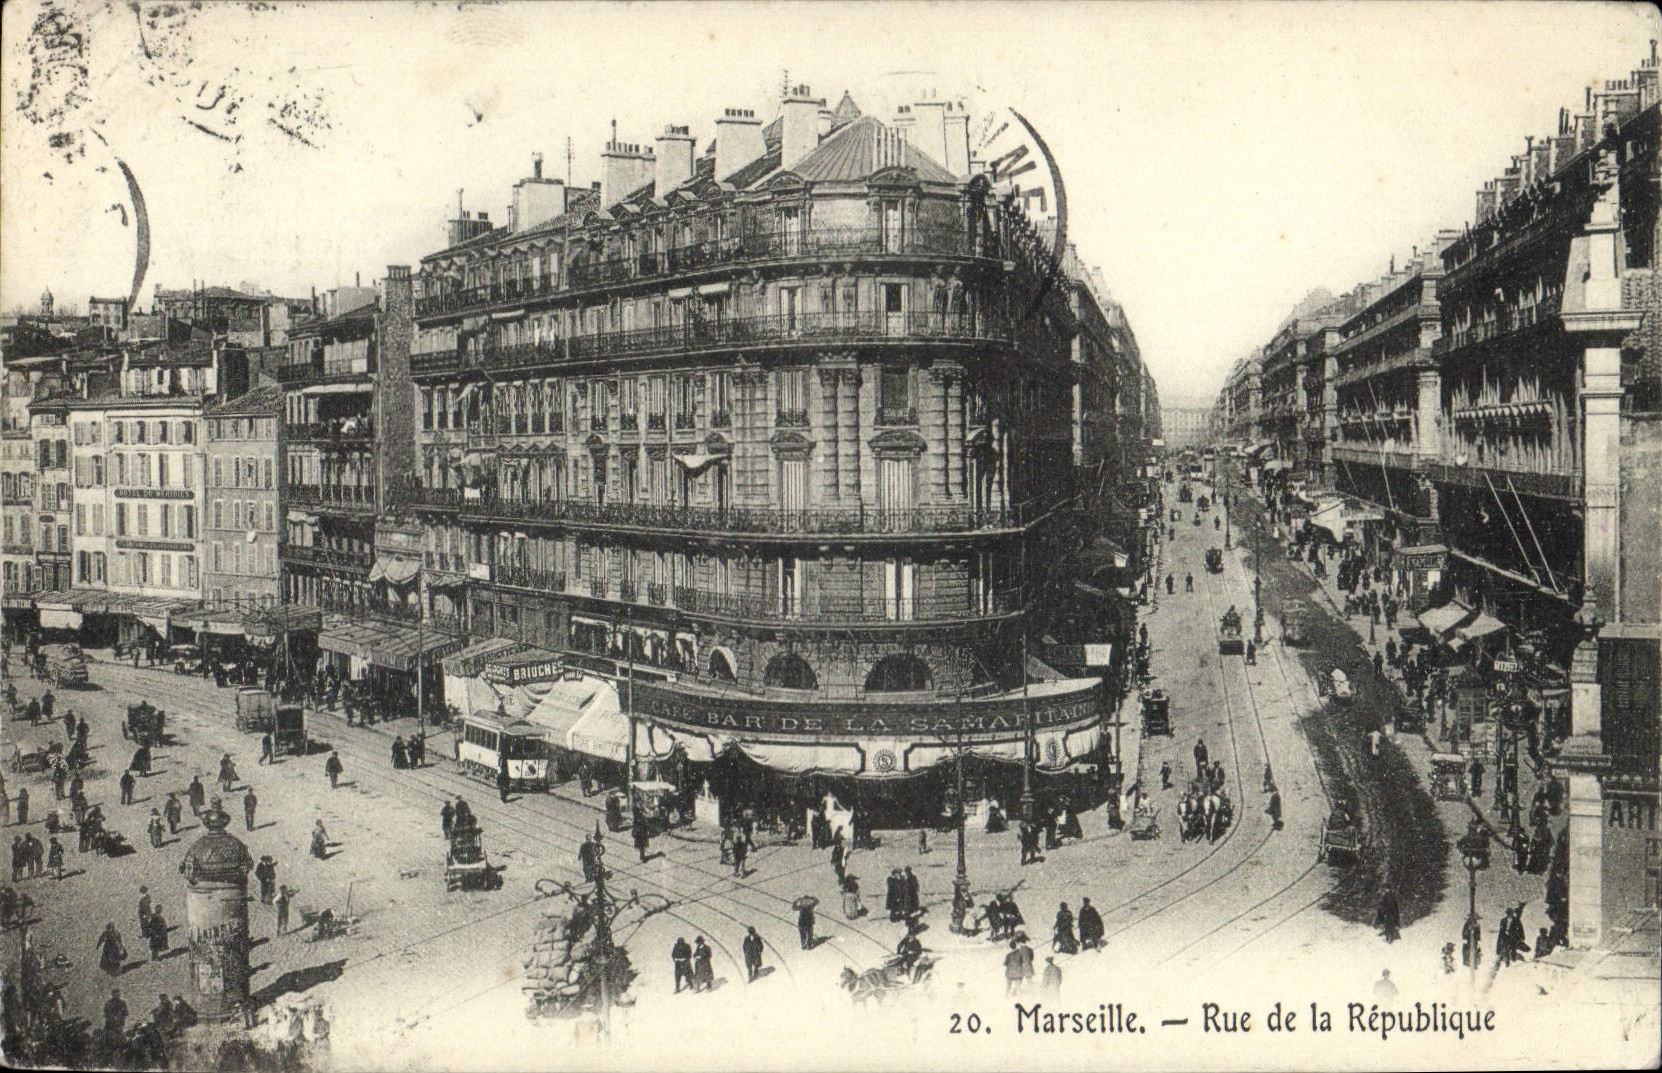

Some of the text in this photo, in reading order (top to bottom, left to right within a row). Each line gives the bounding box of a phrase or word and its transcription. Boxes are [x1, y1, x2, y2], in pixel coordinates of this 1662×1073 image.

[707, 711, 763, 729] BAR
[781, 717, 824, 731] DE
[846, 717, 892, 731] LA
